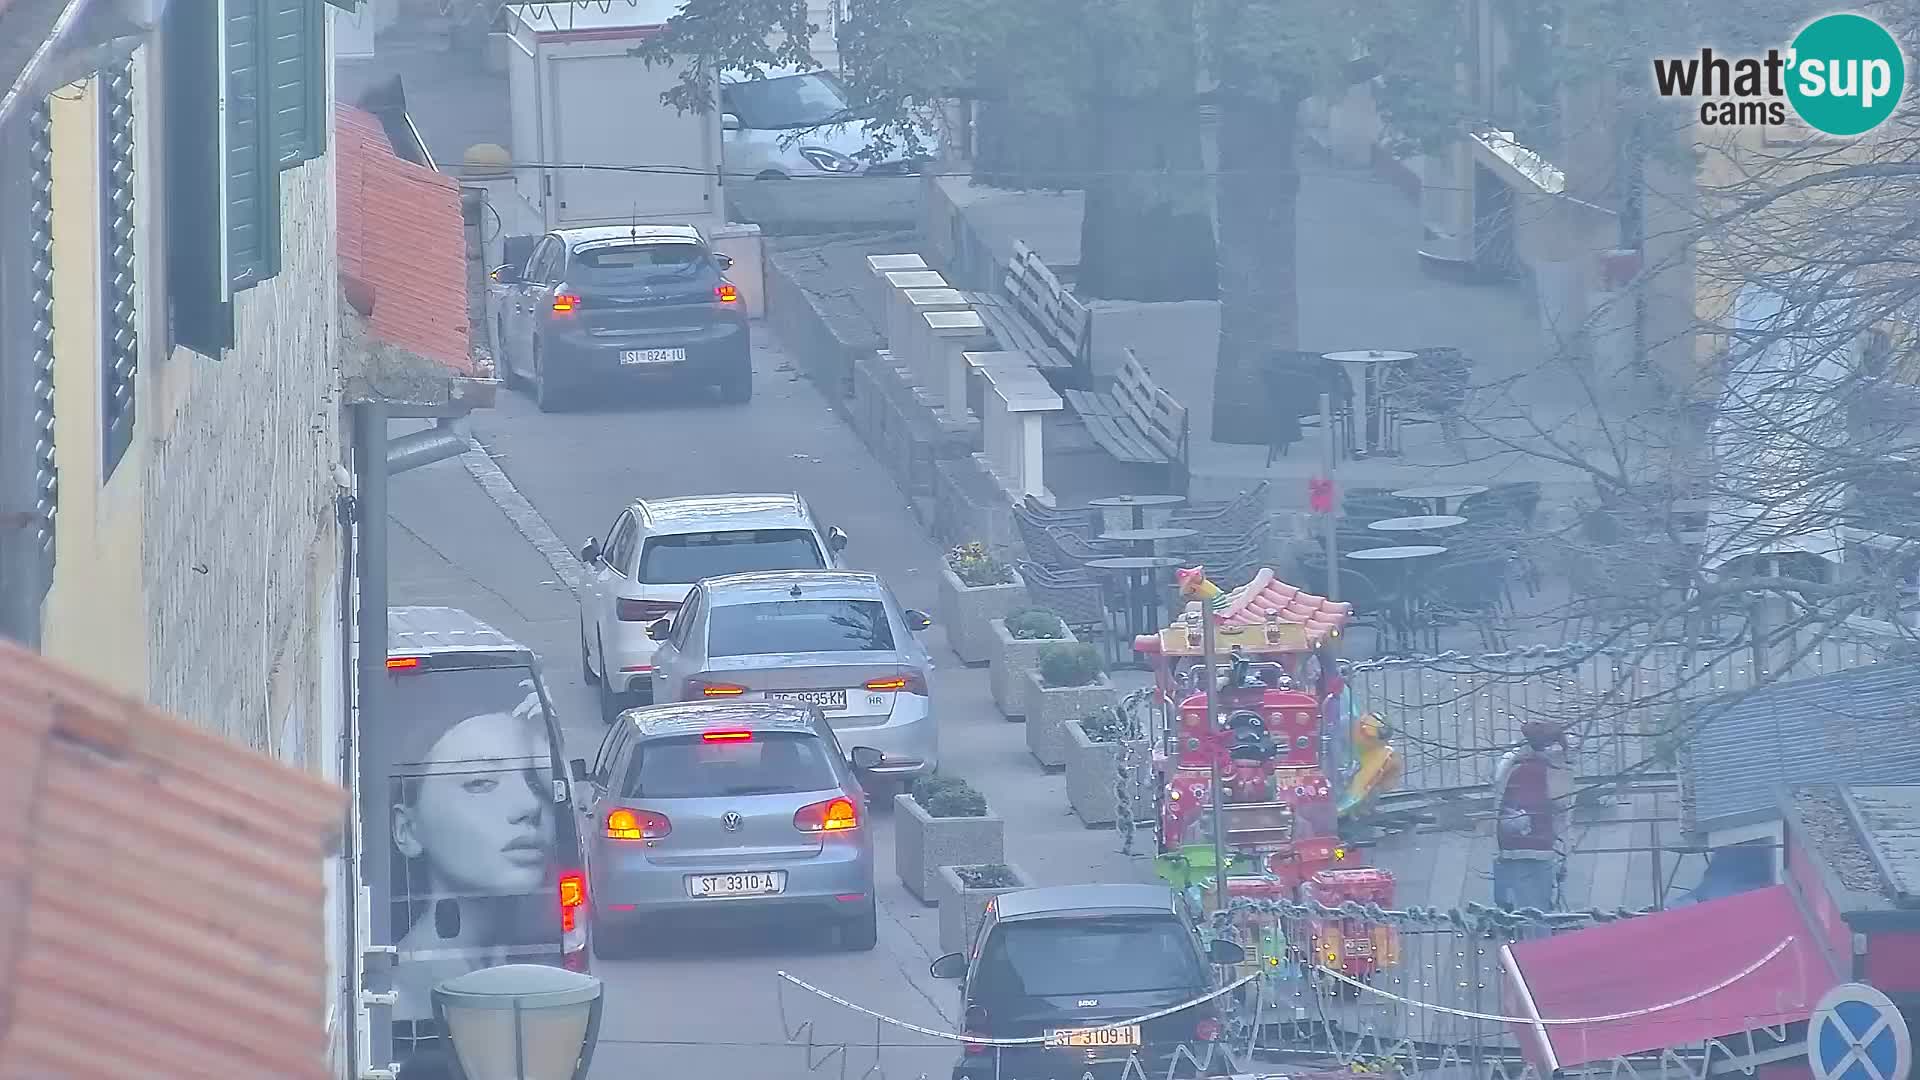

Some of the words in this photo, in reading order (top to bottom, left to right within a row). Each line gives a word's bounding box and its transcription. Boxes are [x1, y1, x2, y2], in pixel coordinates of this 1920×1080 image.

[868, 696, 882, 705] HR
[702, 877, 717, 892] ST
[727, 874, 773, 891] 3310-A
[1055, 1030, 1073, 1046] ST
